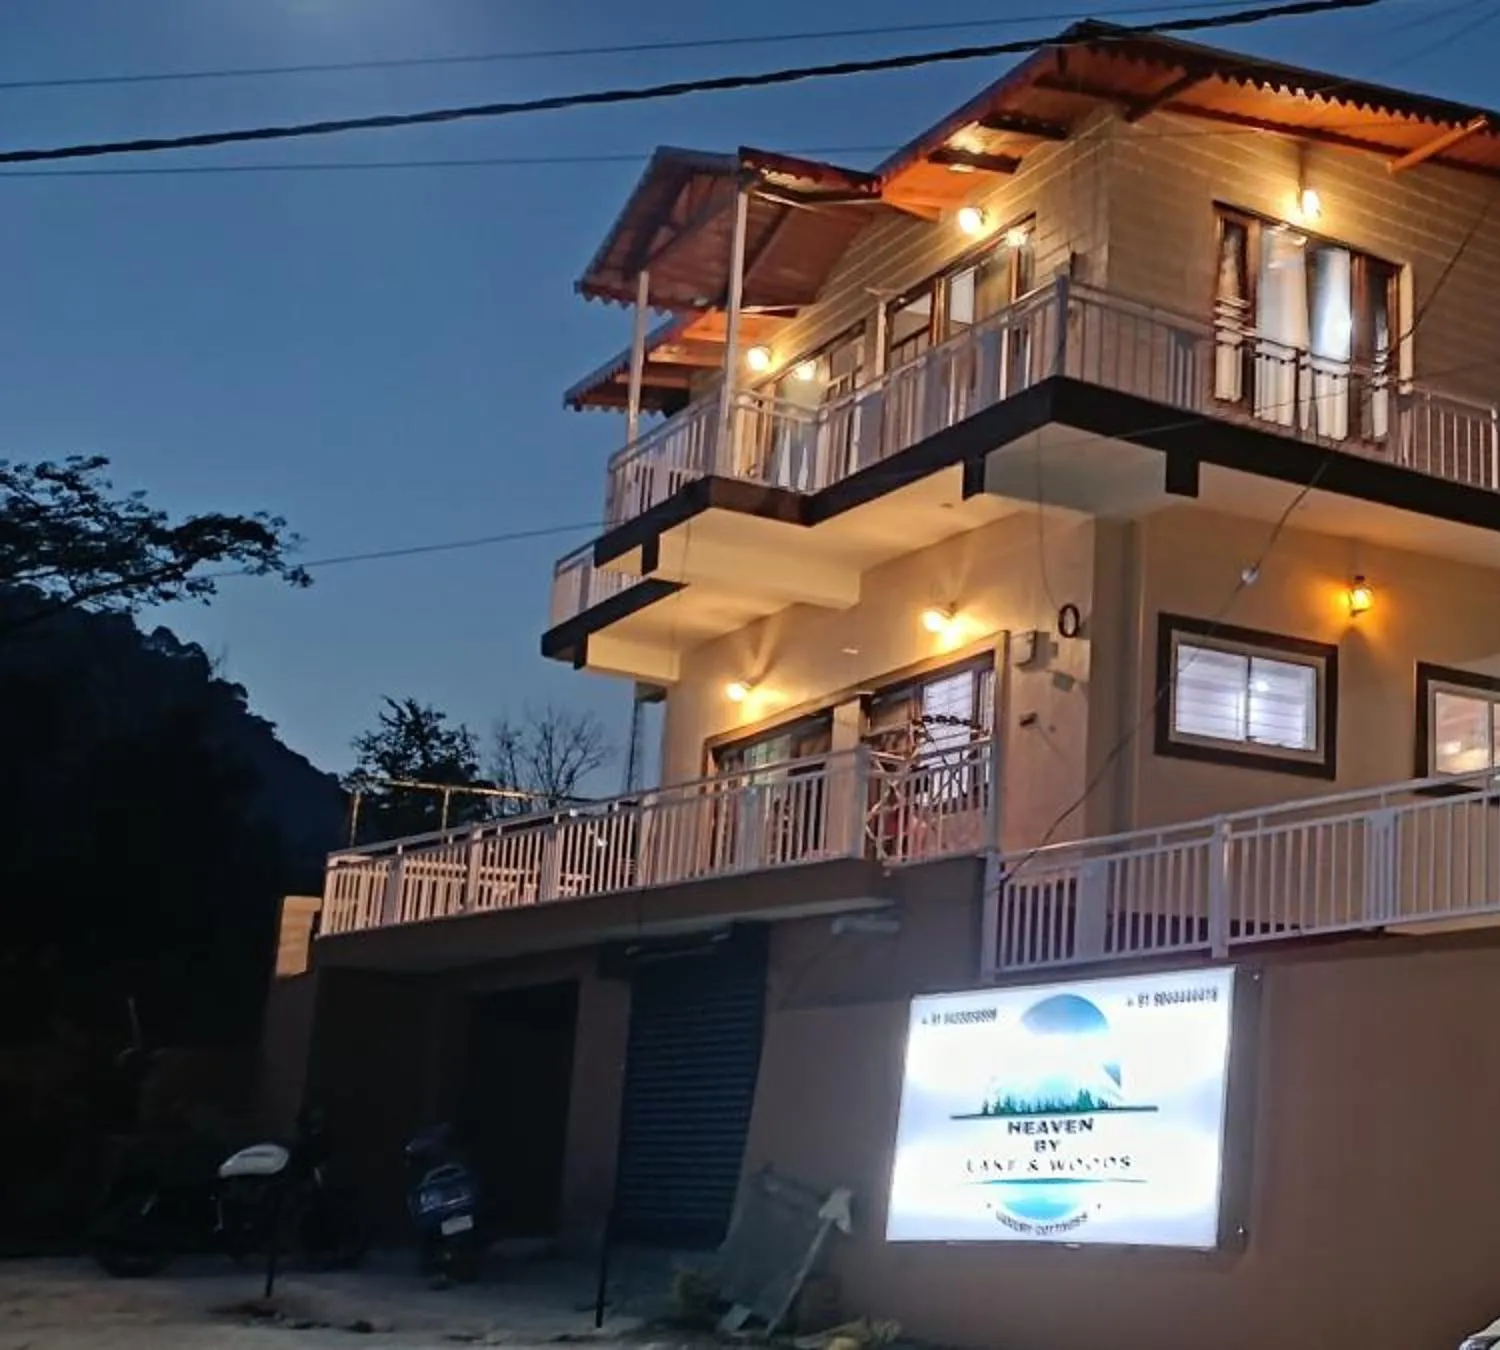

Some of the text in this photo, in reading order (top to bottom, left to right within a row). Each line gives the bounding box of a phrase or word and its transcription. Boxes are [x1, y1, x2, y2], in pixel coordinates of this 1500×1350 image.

[1008, 1118, 1094, 1135] HEAVEN
[1034, 1140, 1060, 1153] BY
[1027, 1159, 1039, 1172] &
[1050, 1155, 1132, 1172] WOODS
